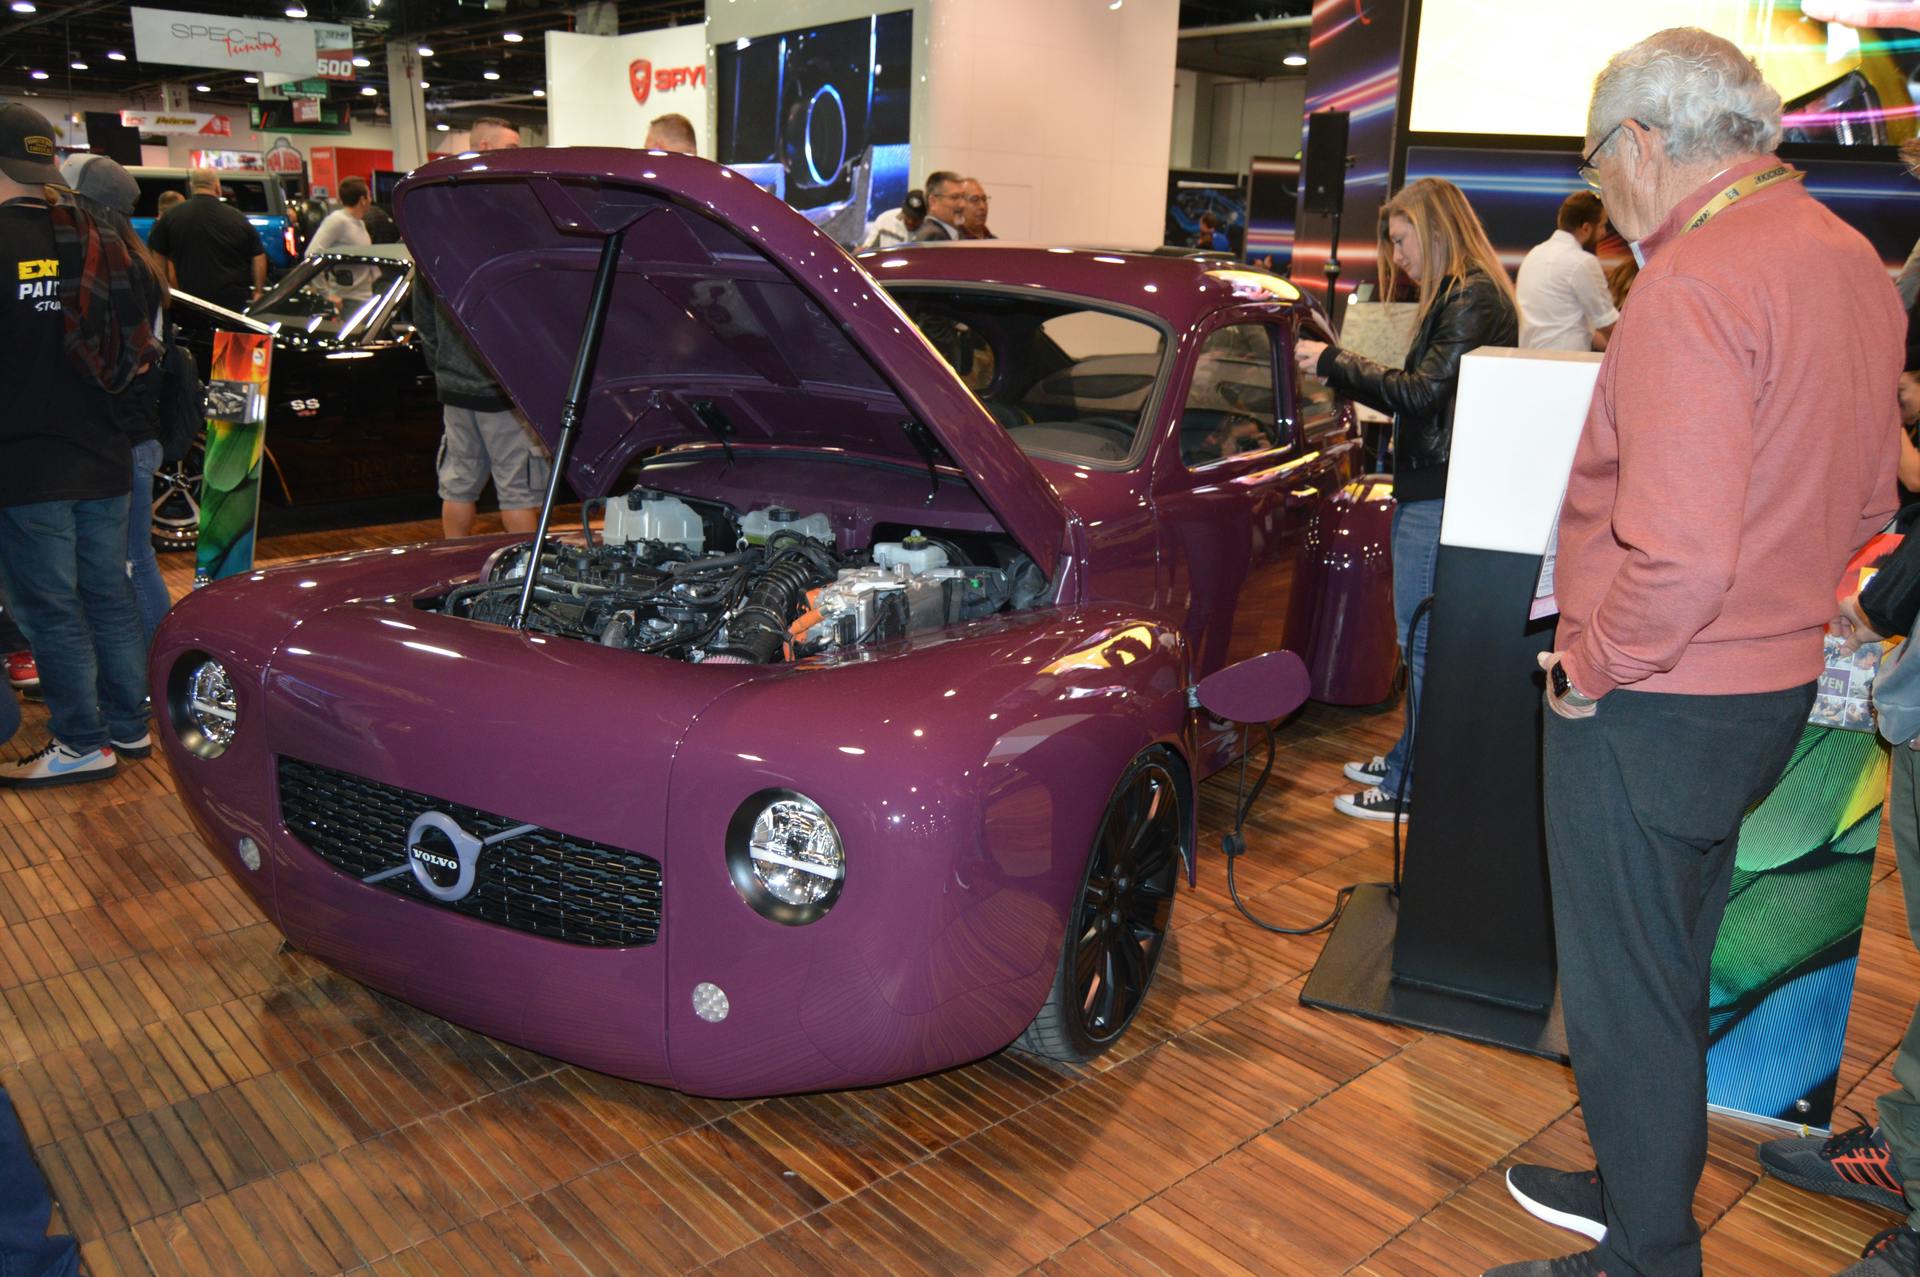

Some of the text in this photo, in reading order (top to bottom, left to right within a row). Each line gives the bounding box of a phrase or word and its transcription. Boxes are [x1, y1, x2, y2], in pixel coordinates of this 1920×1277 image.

[170, 23, 275, 45] SPEC-D
[223, 37, 282, 57] Tuning
[317, 58, 352, 77] 500
[290, 398, 320, 411] SS
[412, 848, 458, 870] VOLVO
